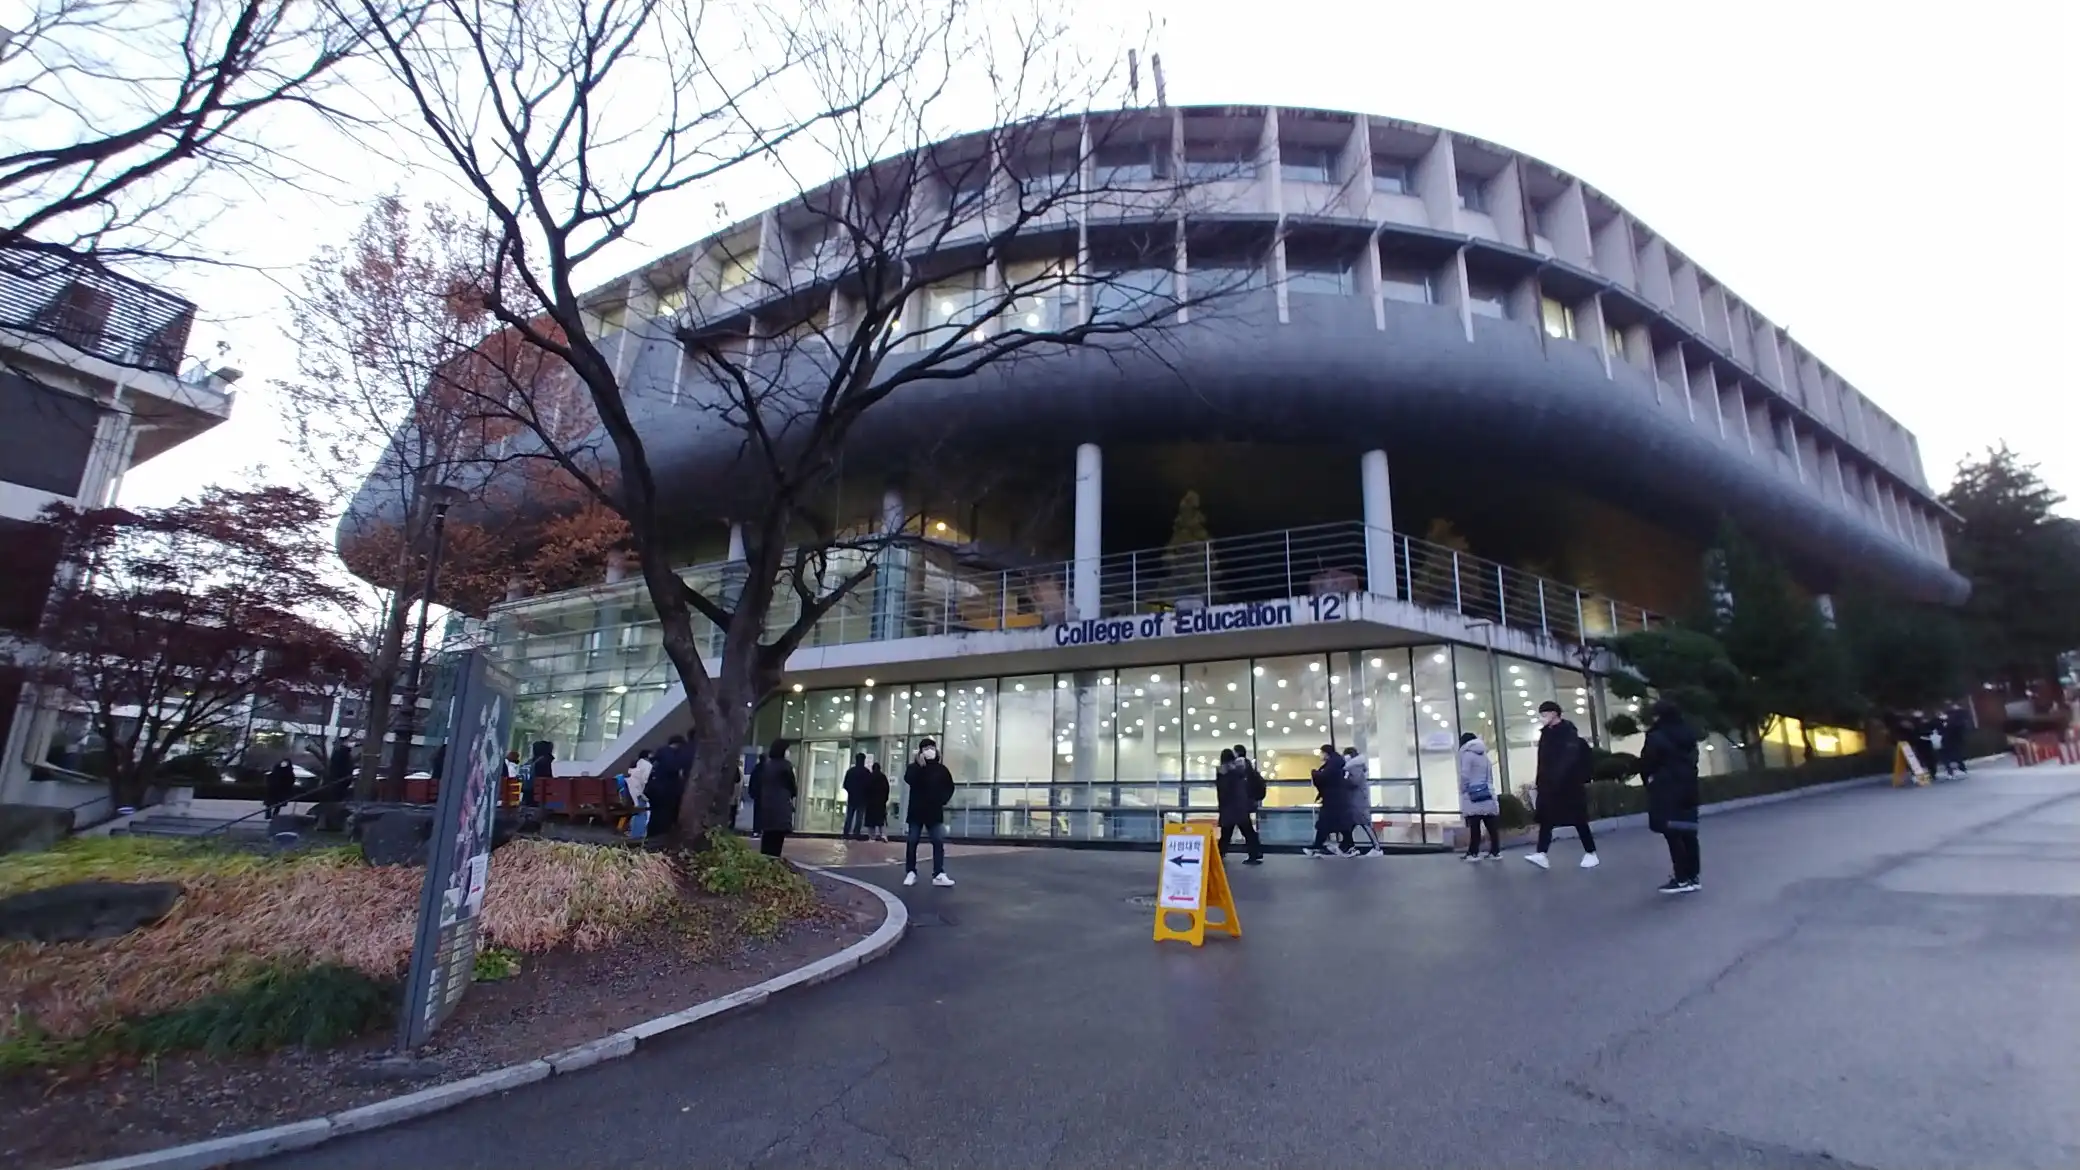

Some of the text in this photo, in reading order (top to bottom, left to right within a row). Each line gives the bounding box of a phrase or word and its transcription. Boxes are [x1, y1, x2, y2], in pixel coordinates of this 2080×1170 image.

[1055, 595, 1341, 646] College of Education 12
